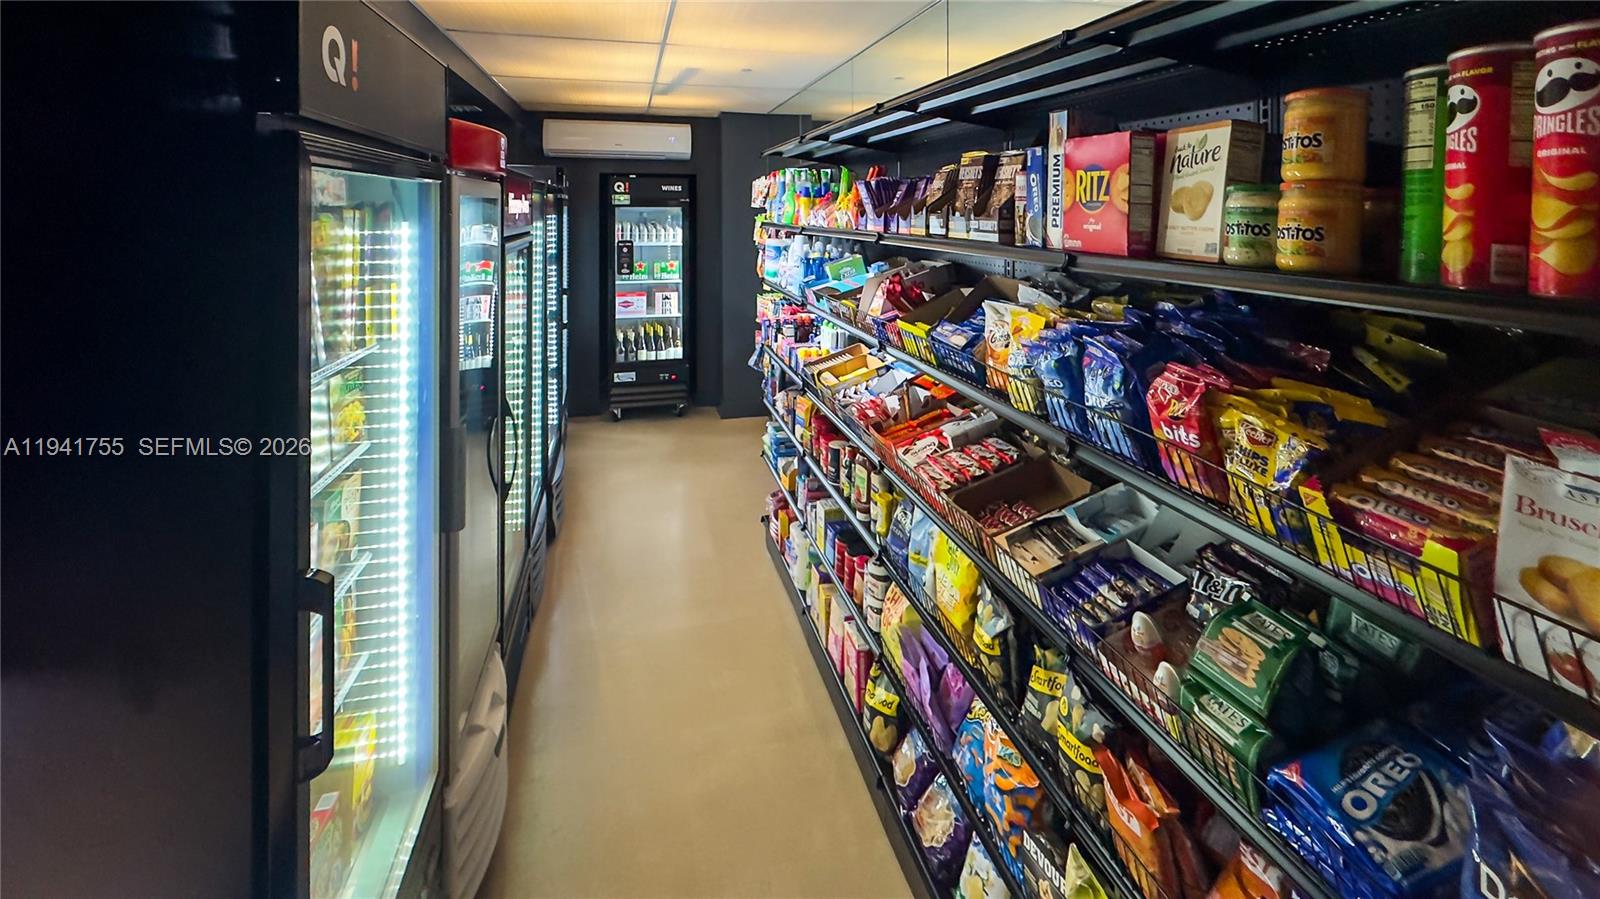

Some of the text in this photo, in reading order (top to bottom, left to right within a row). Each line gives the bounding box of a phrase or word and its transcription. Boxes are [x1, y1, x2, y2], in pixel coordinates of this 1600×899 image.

[321, 25, 359, 91] Q!
[1536, 148, 1587, 158] ORIGINAL
[613, 181, 630, 193] Q!
[1029, 173, 1040, 213] OREO
[1051, 153, 1062, 229] PREMIUM
[1075, 169, 1111, 204] RITZ
[1160, 421, 1201, 448] bits
[1349, 493, 1430, 526] OREO
[1340, 753, 1423, 821] OREO
